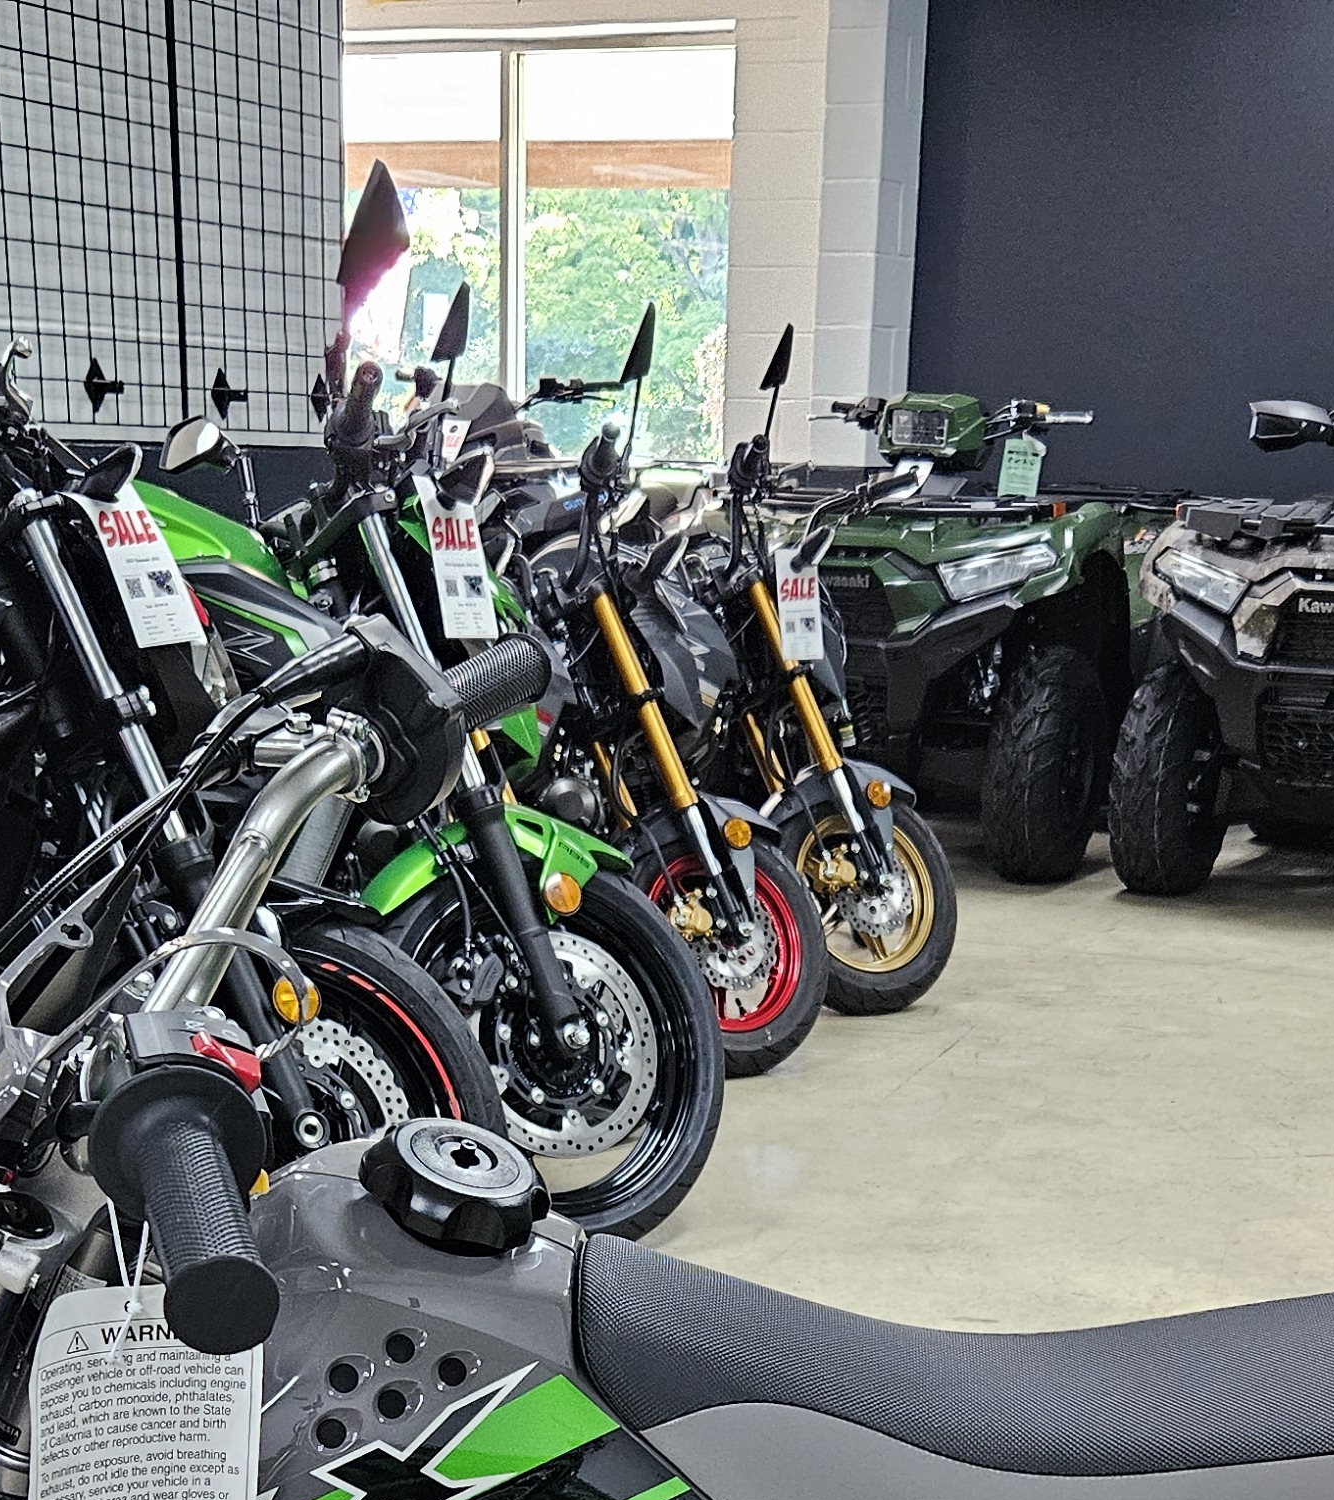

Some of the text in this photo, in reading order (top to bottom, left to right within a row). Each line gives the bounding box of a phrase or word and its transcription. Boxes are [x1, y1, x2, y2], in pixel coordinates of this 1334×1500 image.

[99, 510, 158, 547] SALE
[432, 517, 476, 551] SALE
[780, 577, 816, 602] SALE
[558, 842, 590, 868] ABS
[101, 1325, 179, 1345] WARN
[136, 1351, 156, 1362] and
[41, 1364, 244, 1398] passenger vehicle or off-road vehicle can
[41, 1377, 246, 1410] expose you to chemicals including engine
[79, 1398, 113, 1412] carbon
[117, 1391, 171, 1406] monoxide,
[175, 1391, 235, 1403] phthalates,
[41, 1404, 231, 1438] and lead, which are known to the State
[49, 1429, 92, 1448] California
[95, 1427, 104, 1437] to
[107, 1422, 137, 1435] cause
[141, 1420, 176, 1430] cancer
[180, 1418, 199, 1428] and
[203, 1418, 227, 1429] birth
[41, 1432, 210, 1466] defects or other reproductive harm.
[41, 1449, 227, 1483] To minimize exposure, avoid breathing
[78, 1475, 90, 1486] do
[93, 1471, 107, 1483] not
[111, 1467, 128, 1479] idle
[132, 1466, 148, 1477] the
[151, 1463, 186, 1476] engine
[189, 1464, 225, 1475] except
[227, 1466, 239, 1475] as
[89, 1483, 123, 1497] service
[127, 1480, 149, 1493] your
[152, 1476, 188, 1487] vehicle
[192, 1475, 201, 1486] in
[204, 1477, 211, 1486] a
[153, 1492, 178, 1500] wear
[181, 1489, 215, 1500] gloves
[218, 1492, 229, 1500] or
